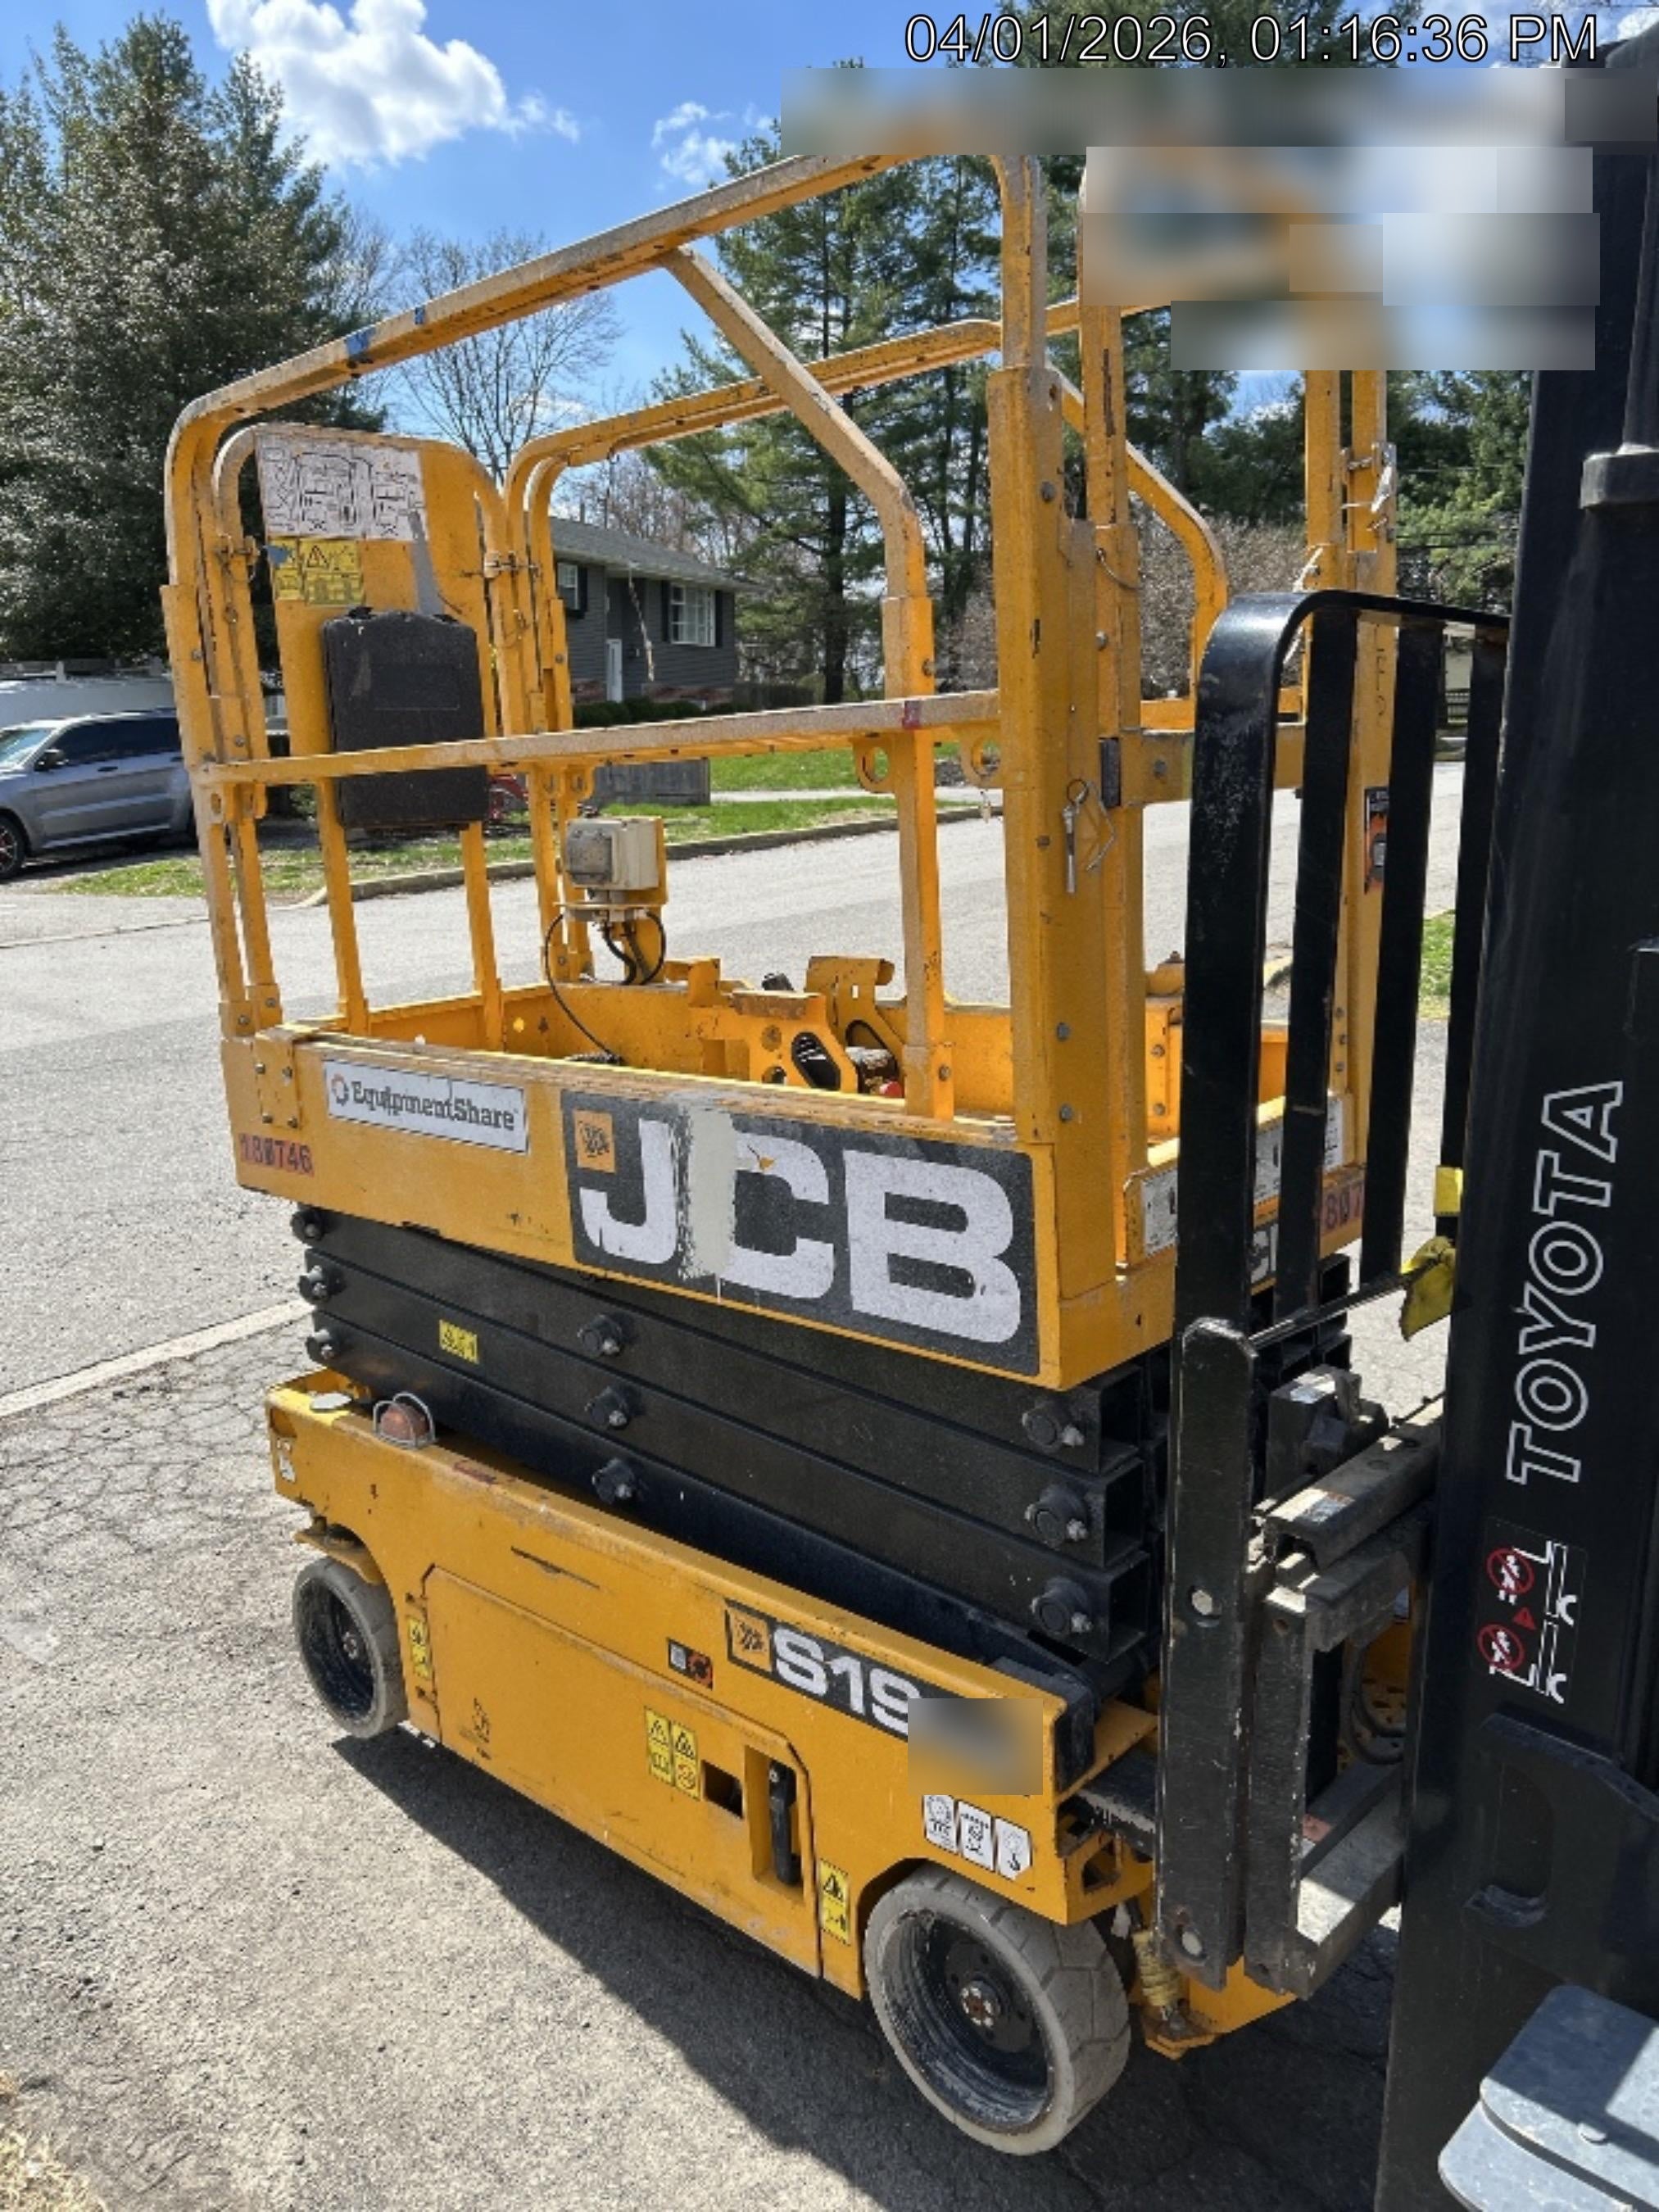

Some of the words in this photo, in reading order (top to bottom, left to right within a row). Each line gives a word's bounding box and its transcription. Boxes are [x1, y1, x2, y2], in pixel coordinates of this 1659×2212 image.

[351, 1081, 515, 1131] EquipmentShare
[579, 1117, 1022, 1344] JCB
[1506, 1080, 1624, 1485] TOYOTA
